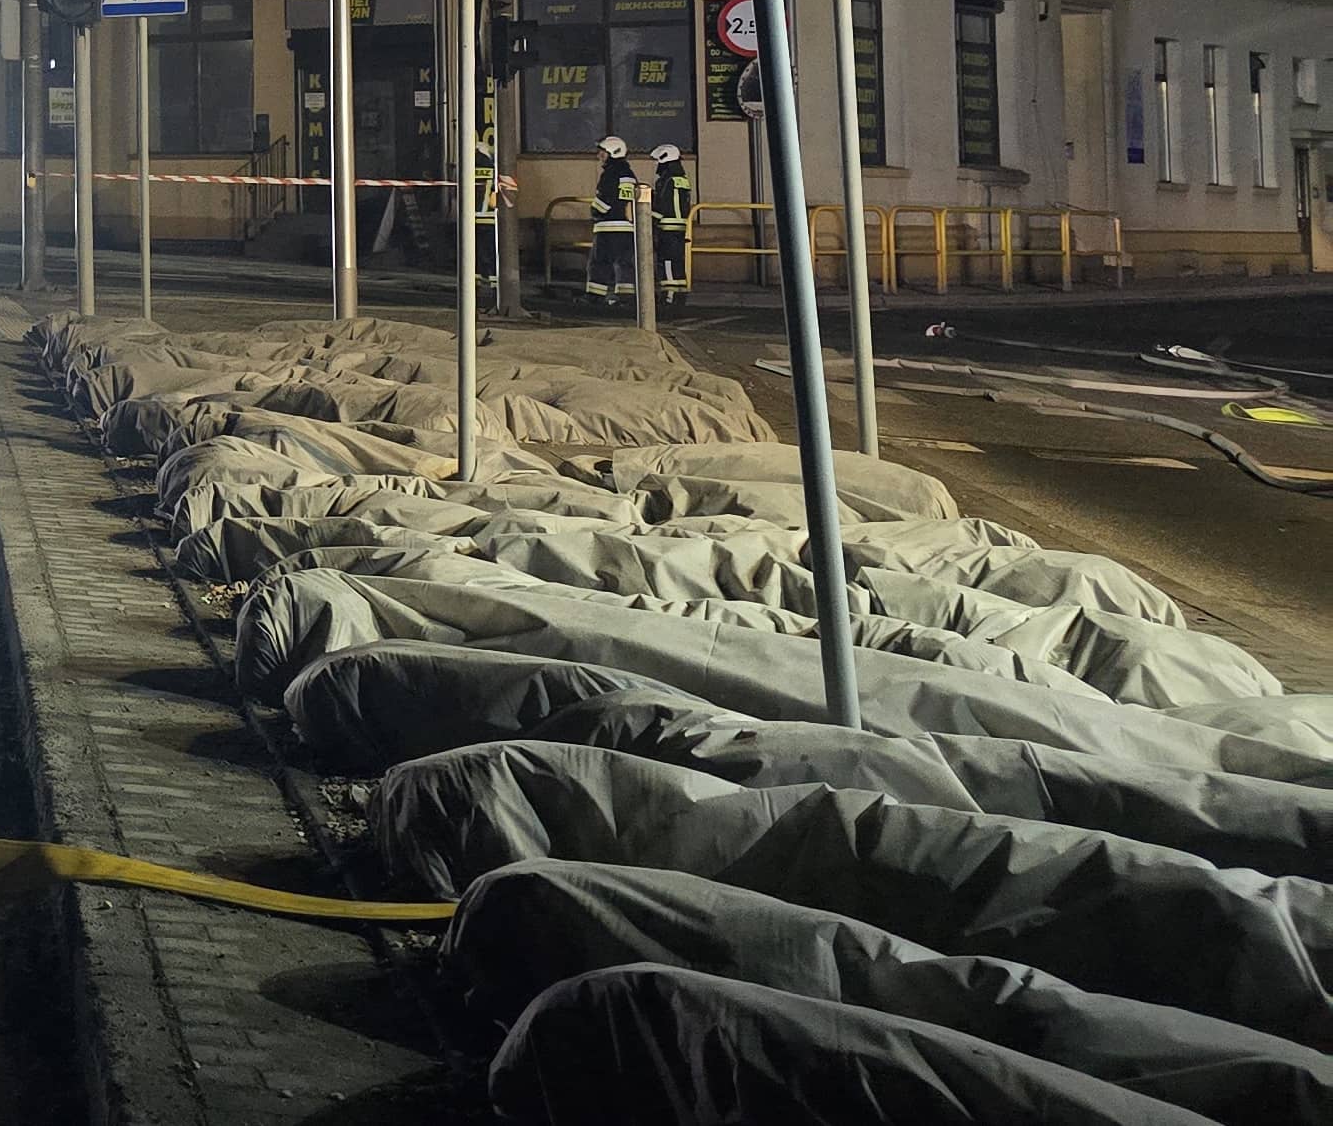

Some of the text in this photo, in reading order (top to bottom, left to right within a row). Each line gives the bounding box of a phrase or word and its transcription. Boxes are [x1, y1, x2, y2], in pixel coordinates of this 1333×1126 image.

[639, 60, 669, 72] BET
[541, 65, 589, 85] LIVE
[637, 72, 668, 83] FAN
[545, 91, 584, 110] BET
